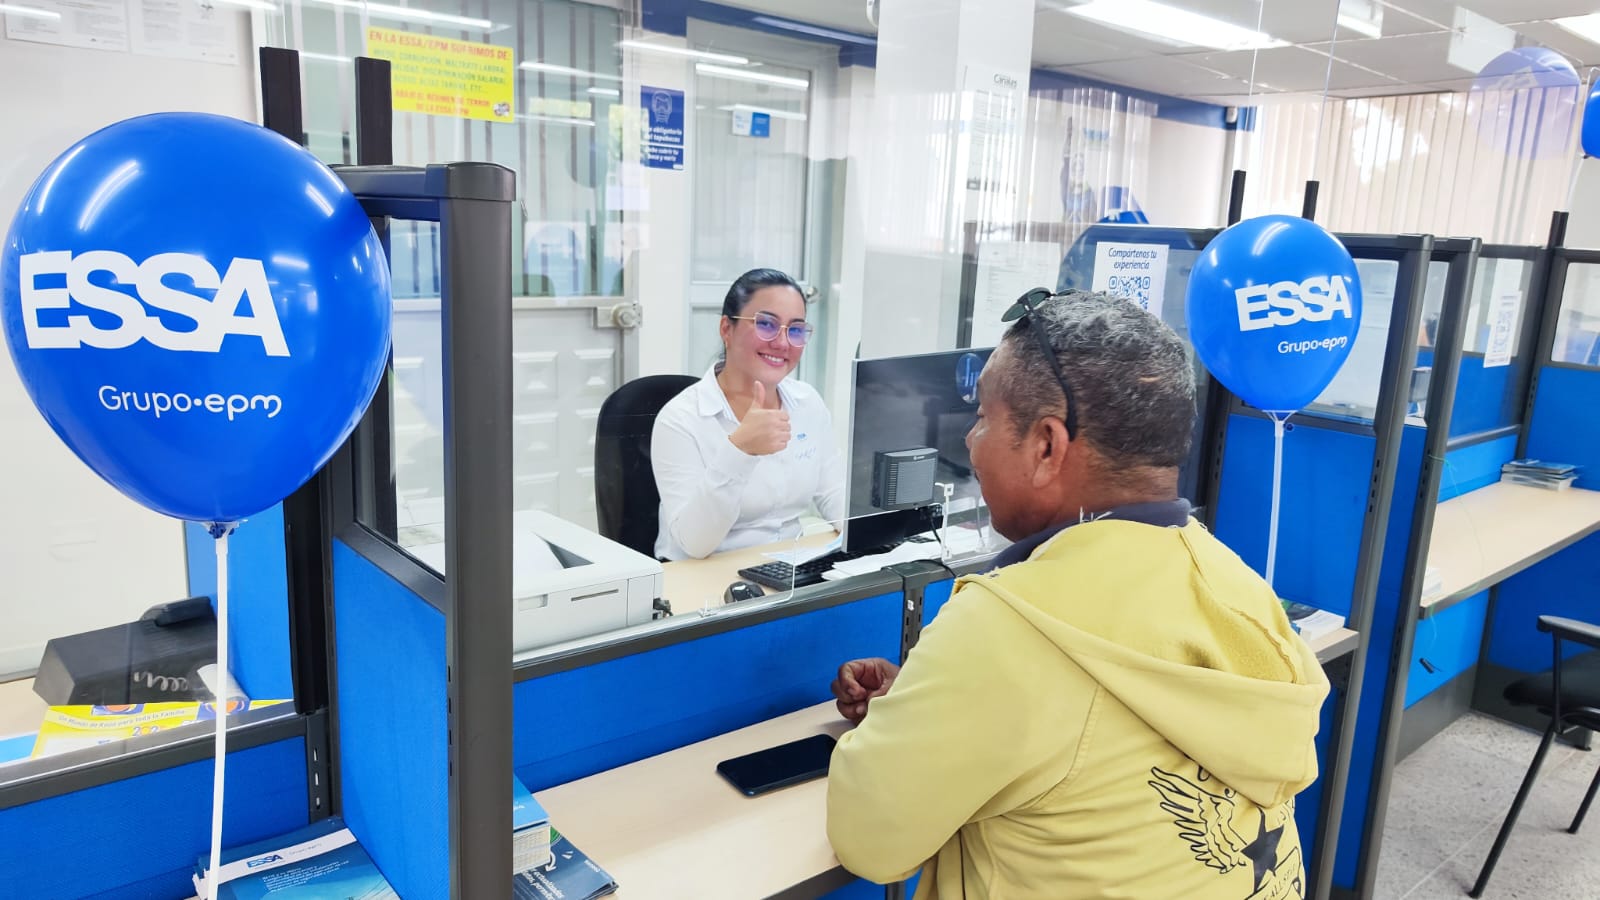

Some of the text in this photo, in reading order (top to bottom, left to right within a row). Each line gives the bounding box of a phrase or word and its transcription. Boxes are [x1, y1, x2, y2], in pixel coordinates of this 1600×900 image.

[370, 30, 381, 40] EN
[385, 32, 397, 44] LA
[451, 43, 495, 58] SUFRIMOS
[1150, 250, 1158, 259] tu
[1114, 260, 1150, 271] experiencia
[20, 250, 290, 357] ESSA
[1234, 275, 1352, 332] ESSA
[247, 854, 283, 868] ESSA
